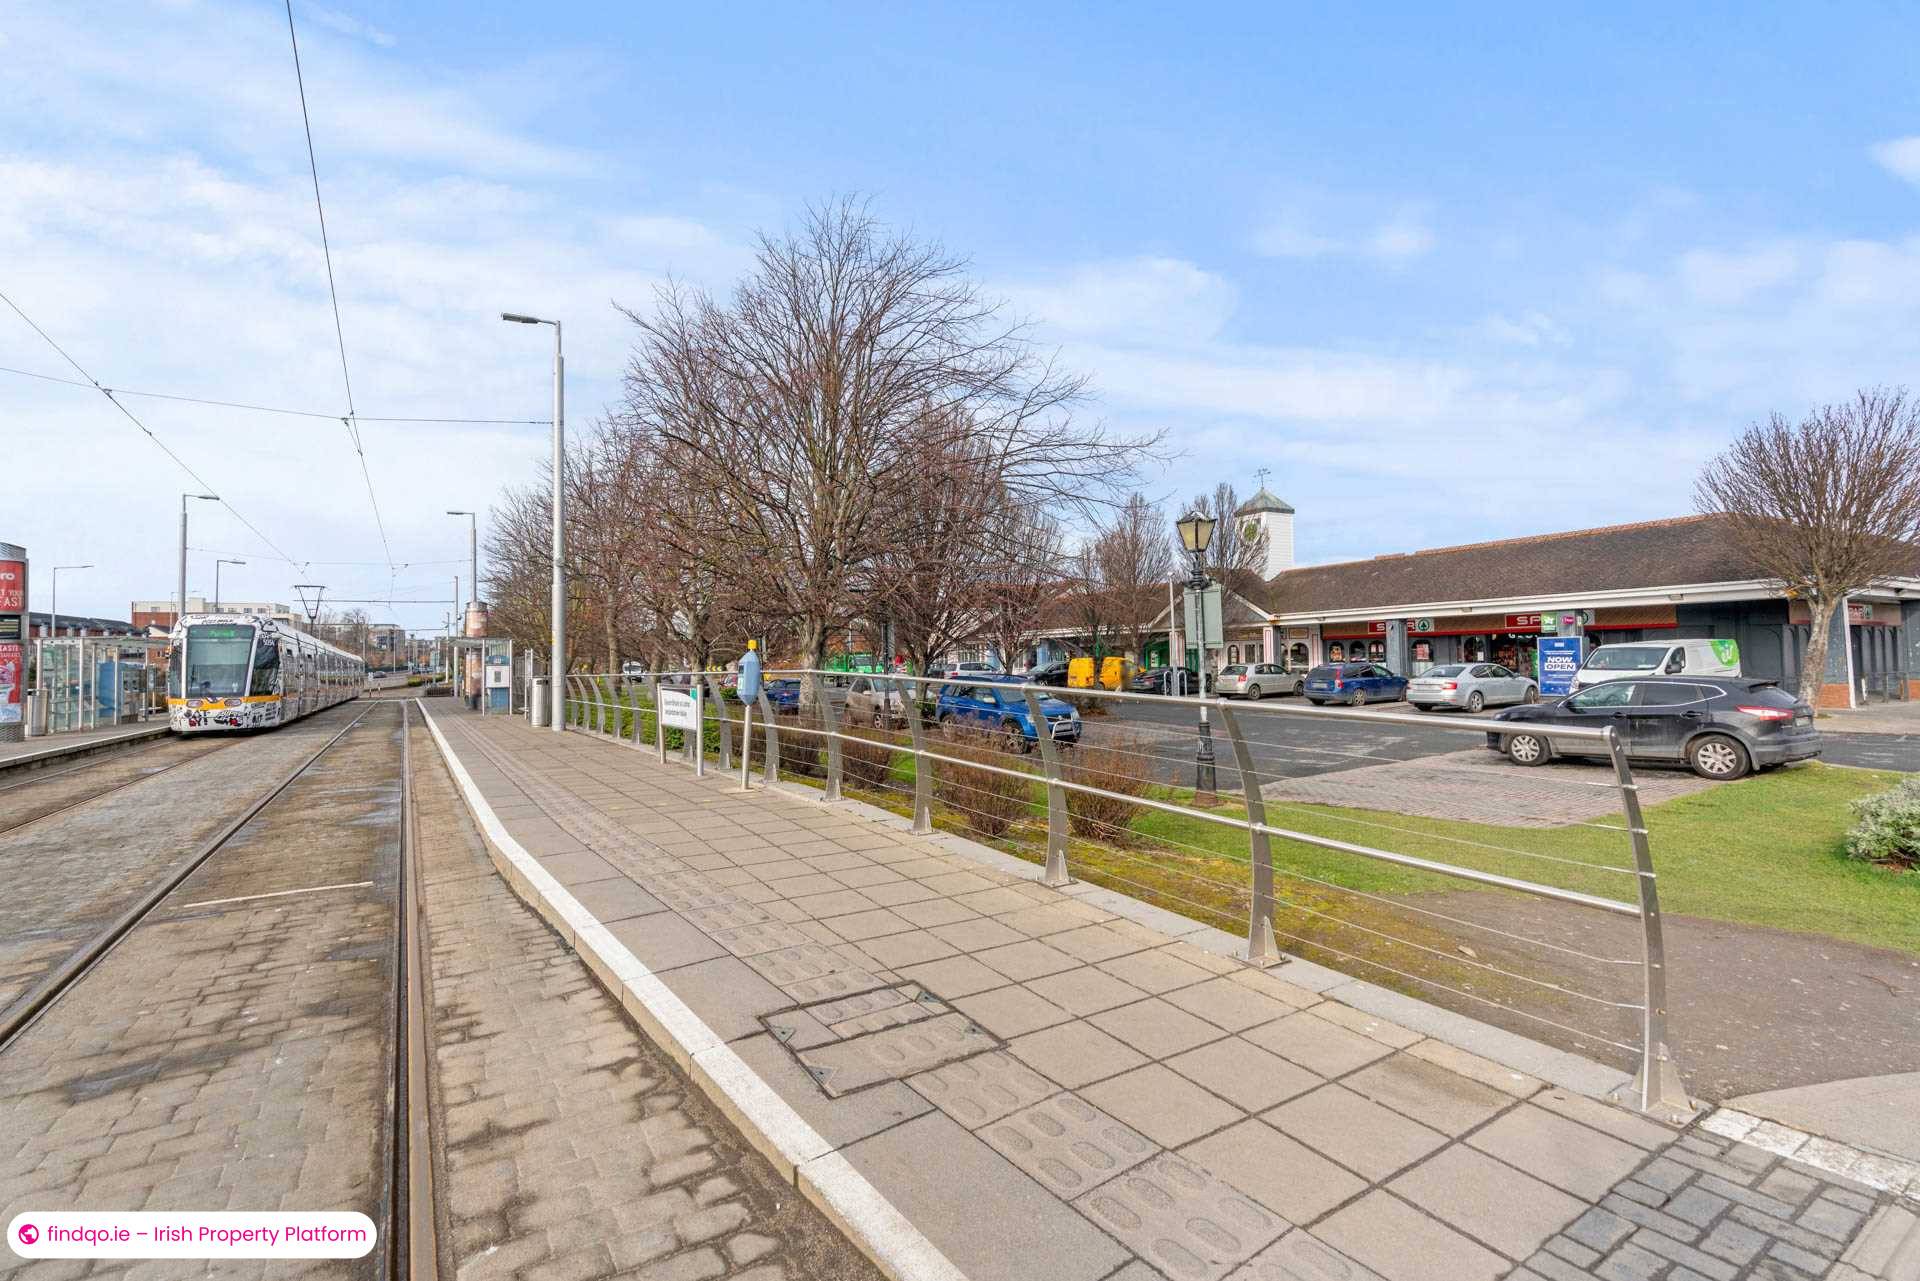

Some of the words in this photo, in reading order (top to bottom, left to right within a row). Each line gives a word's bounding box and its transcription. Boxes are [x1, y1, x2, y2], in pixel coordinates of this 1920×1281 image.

[1516, 615, 1542, 625] SP
[1547, 656, 1573, 664] NOW
[1546, 663, 1574, 671] OPEN
